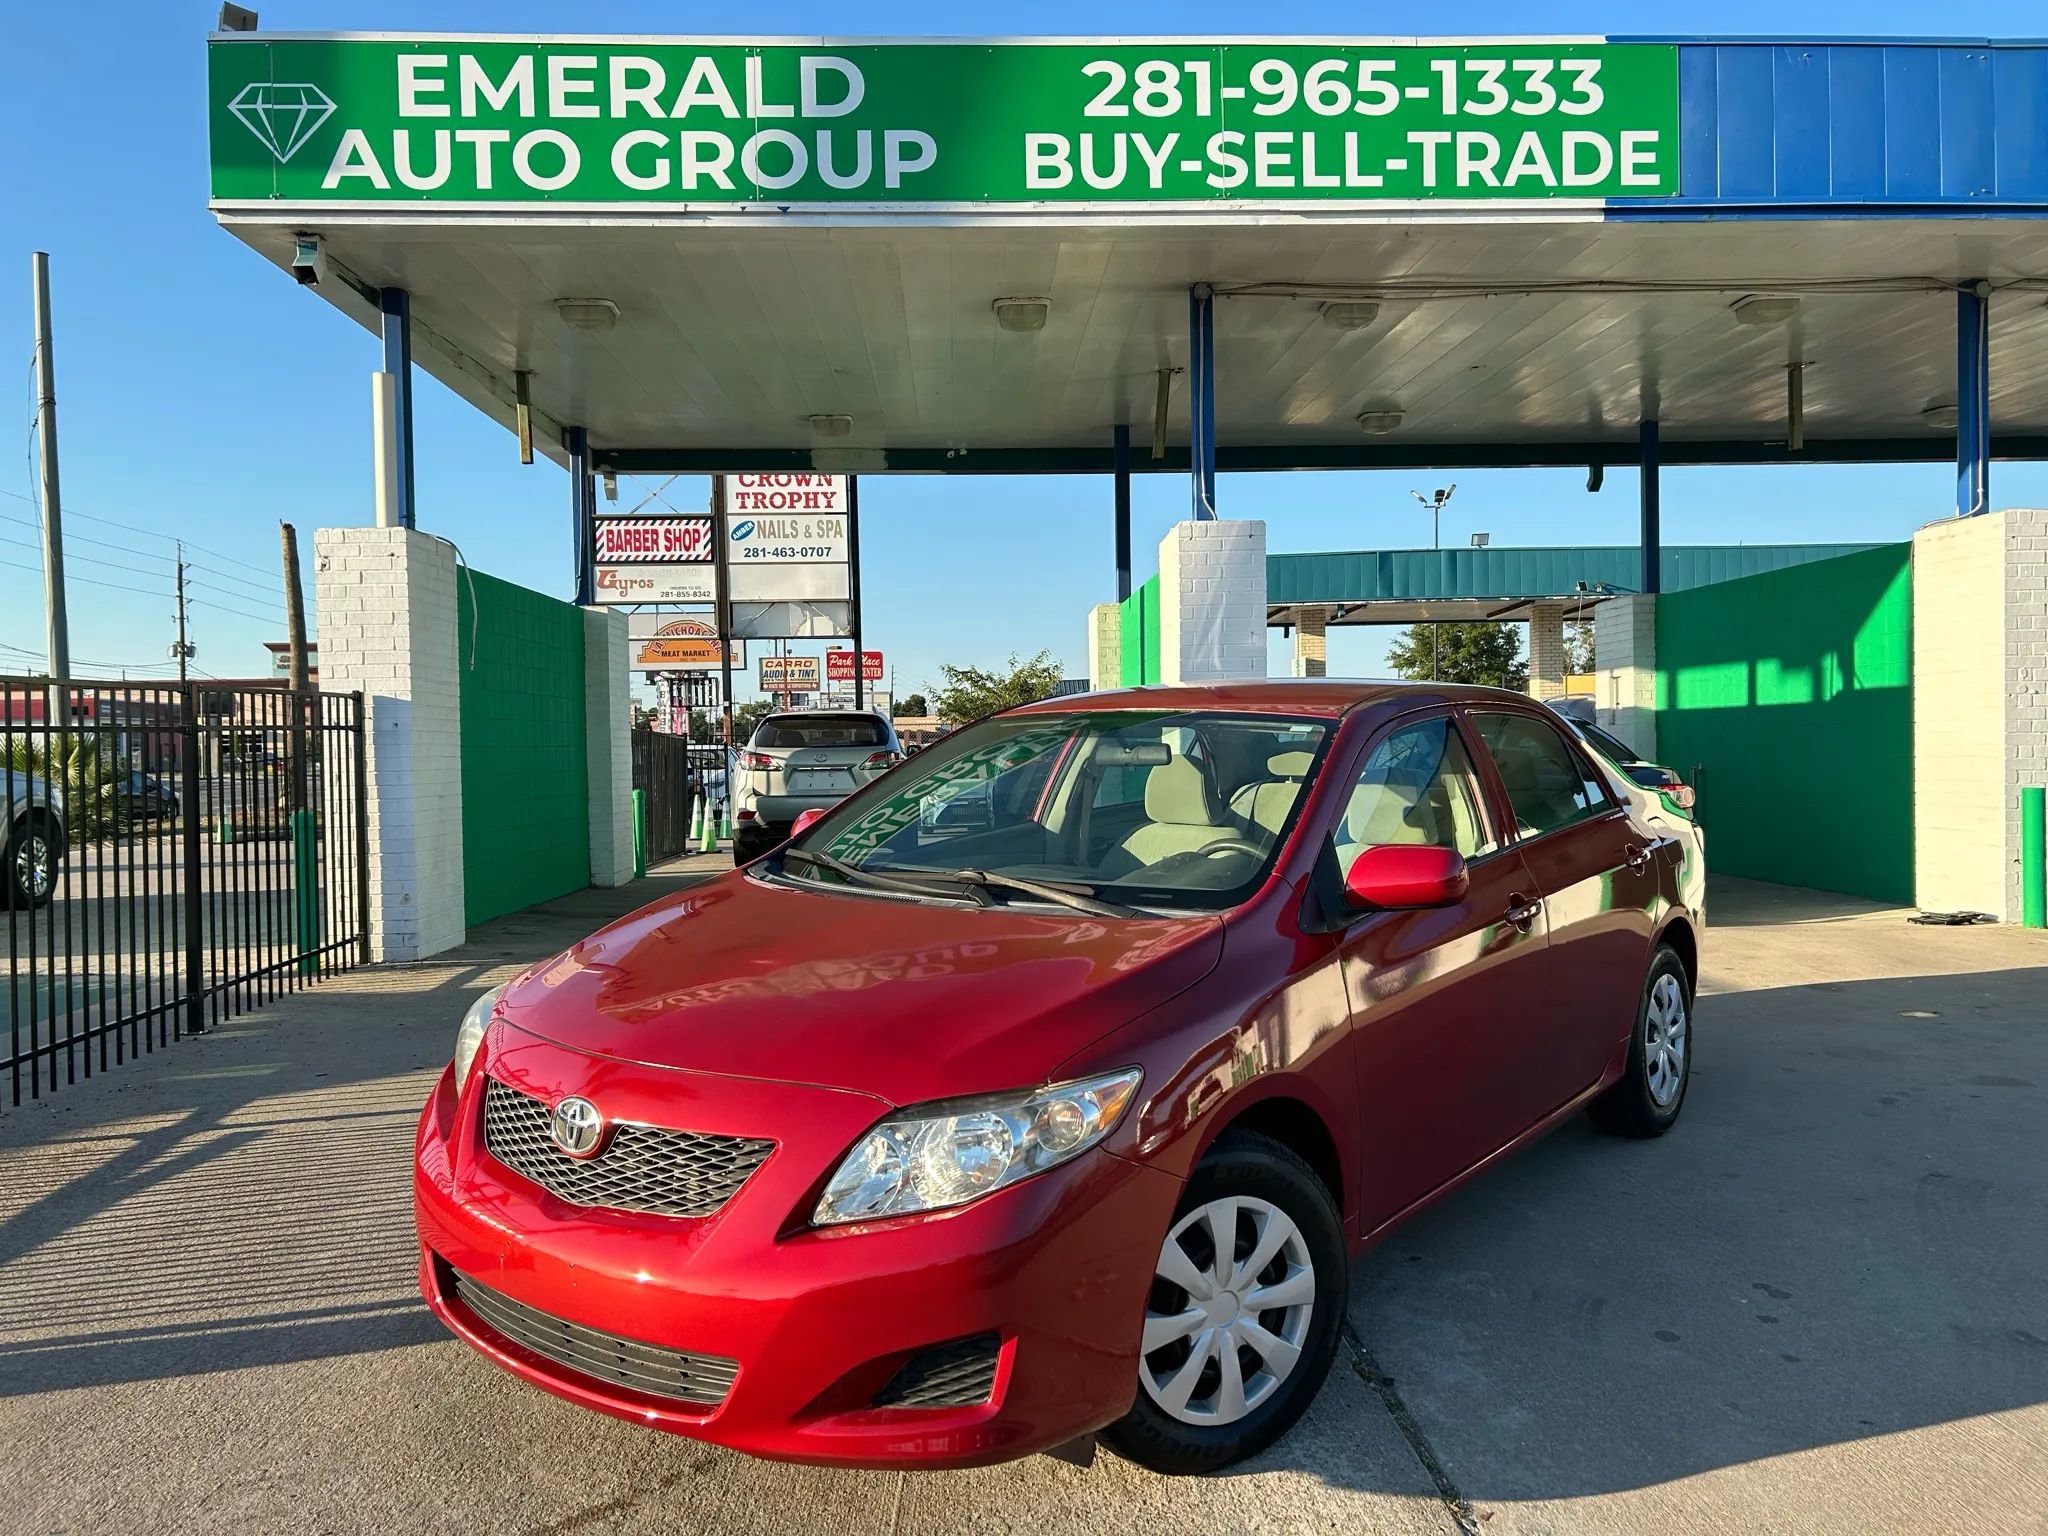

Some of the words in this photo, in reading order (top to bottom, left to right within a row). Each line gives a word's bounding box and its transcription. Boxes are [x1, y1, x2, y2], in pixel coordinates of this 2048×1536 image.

[396, 54, 866, 119] EMERALD
[1081, 58, 1605, 118] 281-965-1333
[321, 128, 582, 191] AUTO
[610, 128, 938, 191] GROUP
[1025, 129, 1660, 190] BUY-SELL-TRADE
[738, 472, 833, 488] CROWN
[735, 492, 837, 509] TROPHY
[733, 522, 754, 540] AMBER
[757, 520, 799, 539] NAILS
[804, 524, 812, 539] &
[817, 519, 843, 539] SPA
[606, 529, 659, 552] BARBER
[664, 528, 702, 552] SHOP
[744, 547, 832, 558] 281-463-0707
[597, 570, 654, 597] Gyros
[661, 650, 681, 658] MEAT
[830, 654, 853, 666] Park
[862, 655, 881, 666] lace
[765, 660, 813, 668] CARRO
[828, 667, 856, 678] SHOPPIN
[862, 667, 882, 678] ENTER
[790, 669, 796, 678] &
[798, 669, 816, 678] TINT
